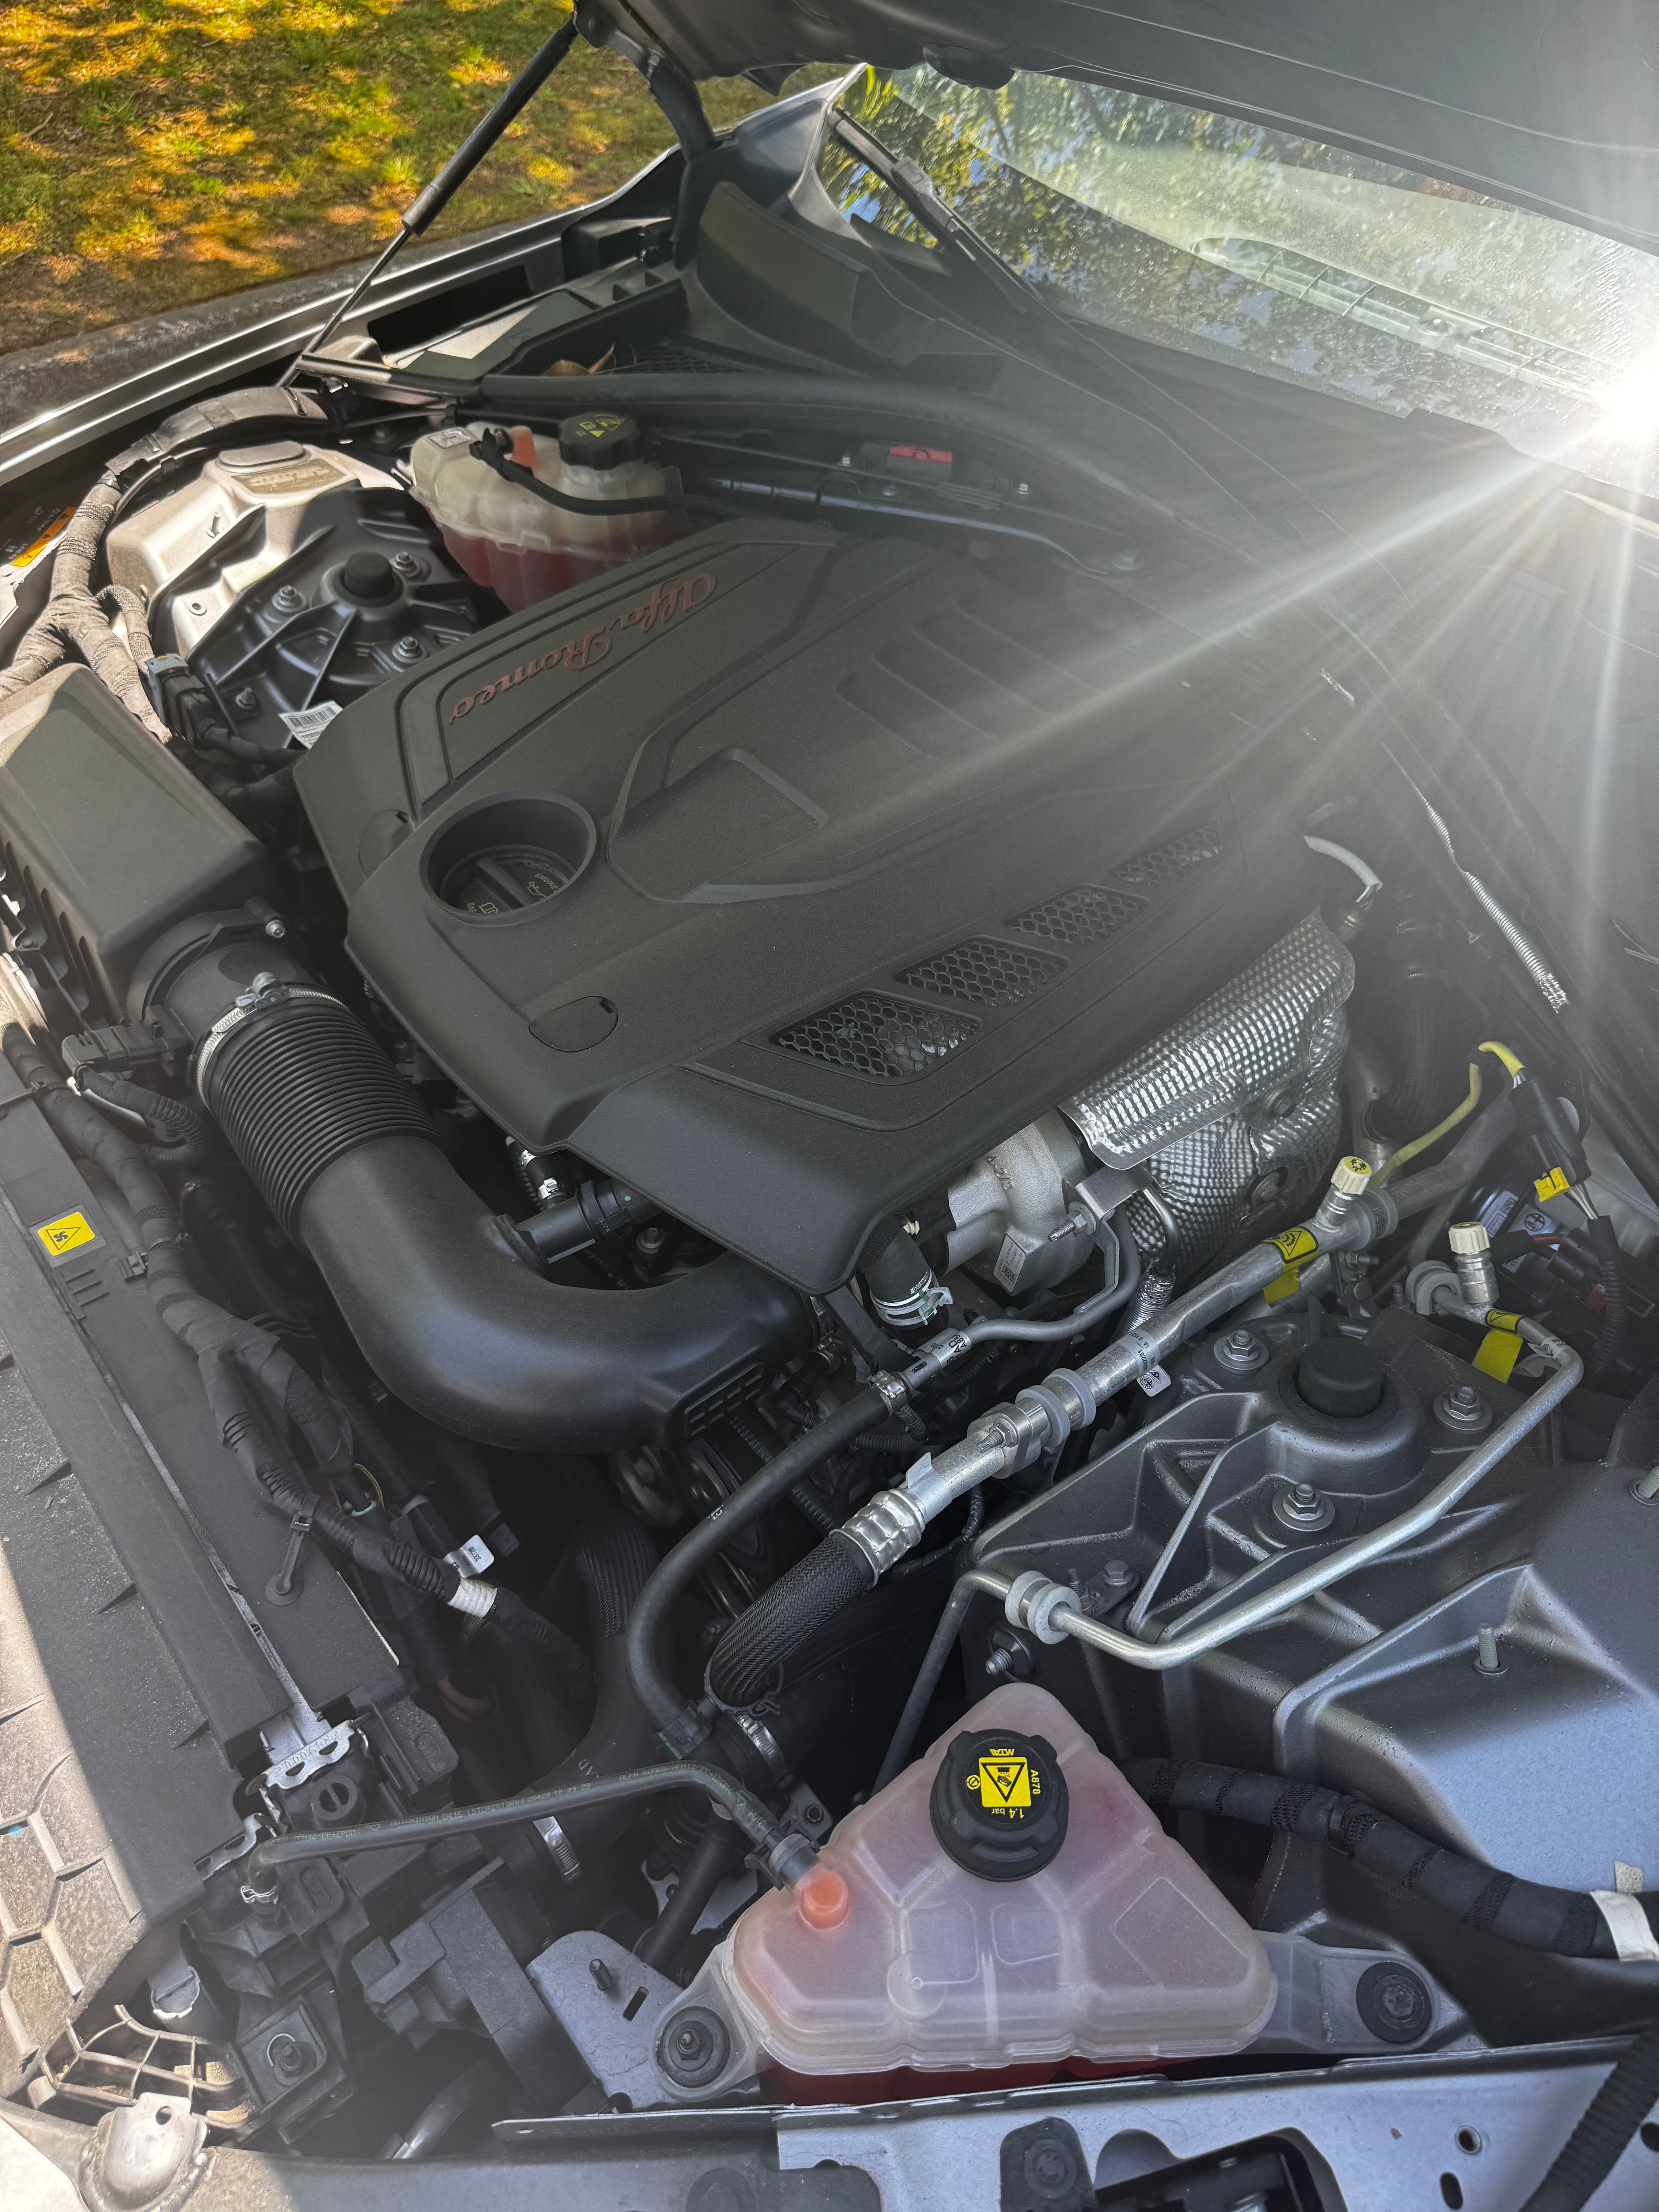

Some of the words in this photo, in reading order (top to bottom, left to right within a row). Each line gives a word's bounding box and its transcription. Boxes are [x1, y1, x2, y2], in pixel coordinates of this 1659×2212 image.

[609, 573, 717, 634] Alfa
[448, 626, 611, 725] Romeo
[534, 873, 558, 890] ENGINE
[1030, 1769, 1041, 1795] A878
[1009, 1808, 1024, 1819] 1.4
